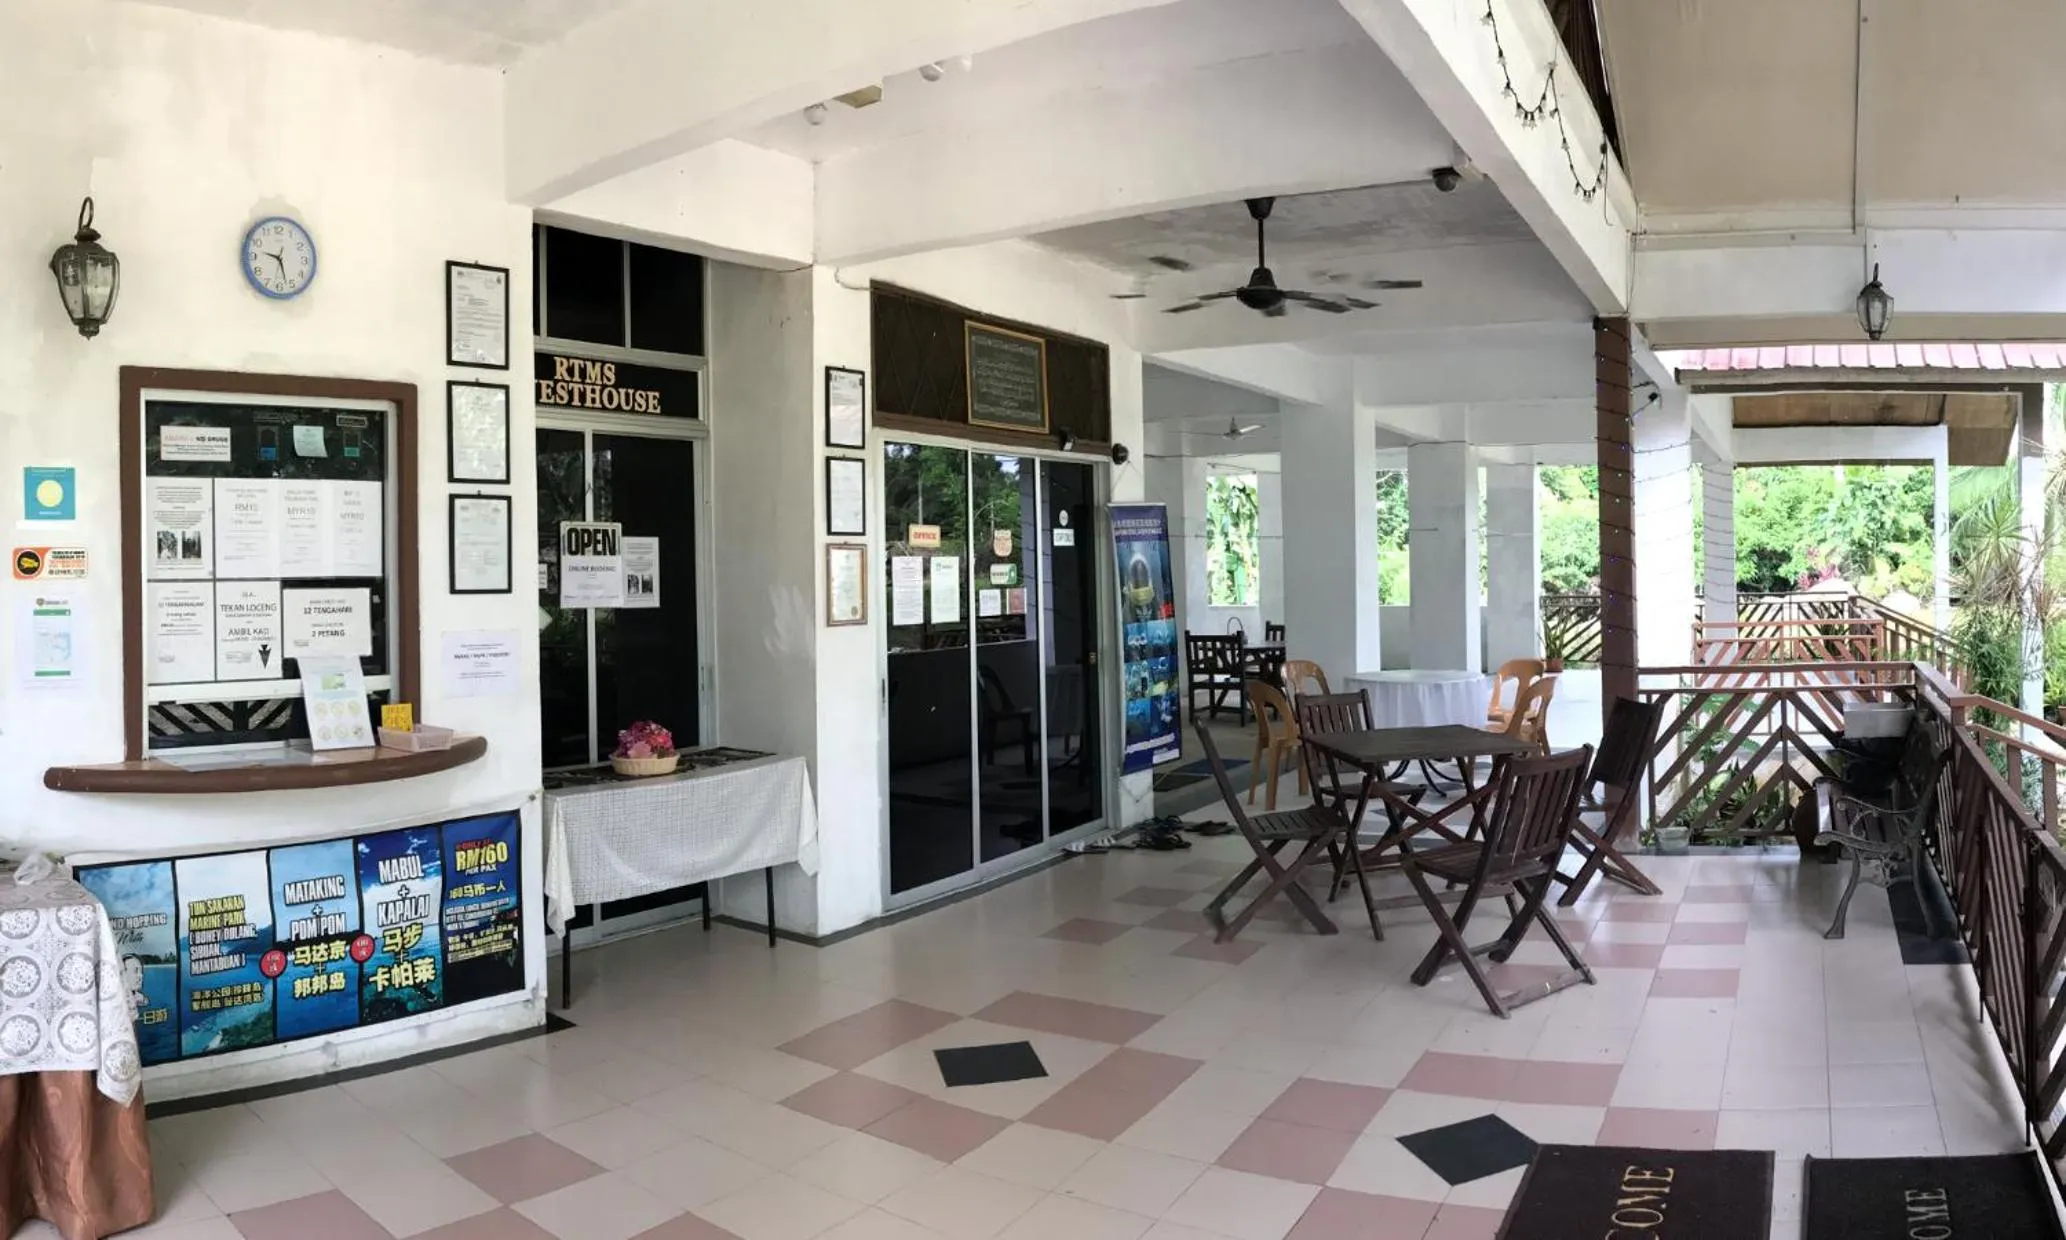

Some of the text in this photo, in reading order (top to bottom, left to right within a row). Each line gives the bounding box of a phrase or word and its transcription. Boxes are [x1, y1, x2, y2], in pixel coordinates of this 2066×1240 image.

[274, 225, 284, 235] 12
[296, 241, 304, 251] 2
[300, 255, 308, 265] 3
[554, 356, 616, 386] RTMS
[537, 379, 661, 414] ESTHOUSE
[567, 528, 617, 556] OPEN
[220, 604, 245, 612] TEKAN
[378, 854, 424, 884] MABUL
[455, 841, 508, 872] RM160
[480, 864, 497, 874] PAX
[285, 875, 346, 907] MATAKING
[126, 913, 167, 930] HOPPING
[189, 901, 206, 916] TUN
[190, 911, 246, 931] MARINE PARK
[377, 894, 431, 928] KAPALAI
[291, 912, 346, 941] POM POM
[382, 922, 424, 953] 马步
[294, 940, 347, 967] 马达京
[369, 957, 436, 993] 卡帕莱
